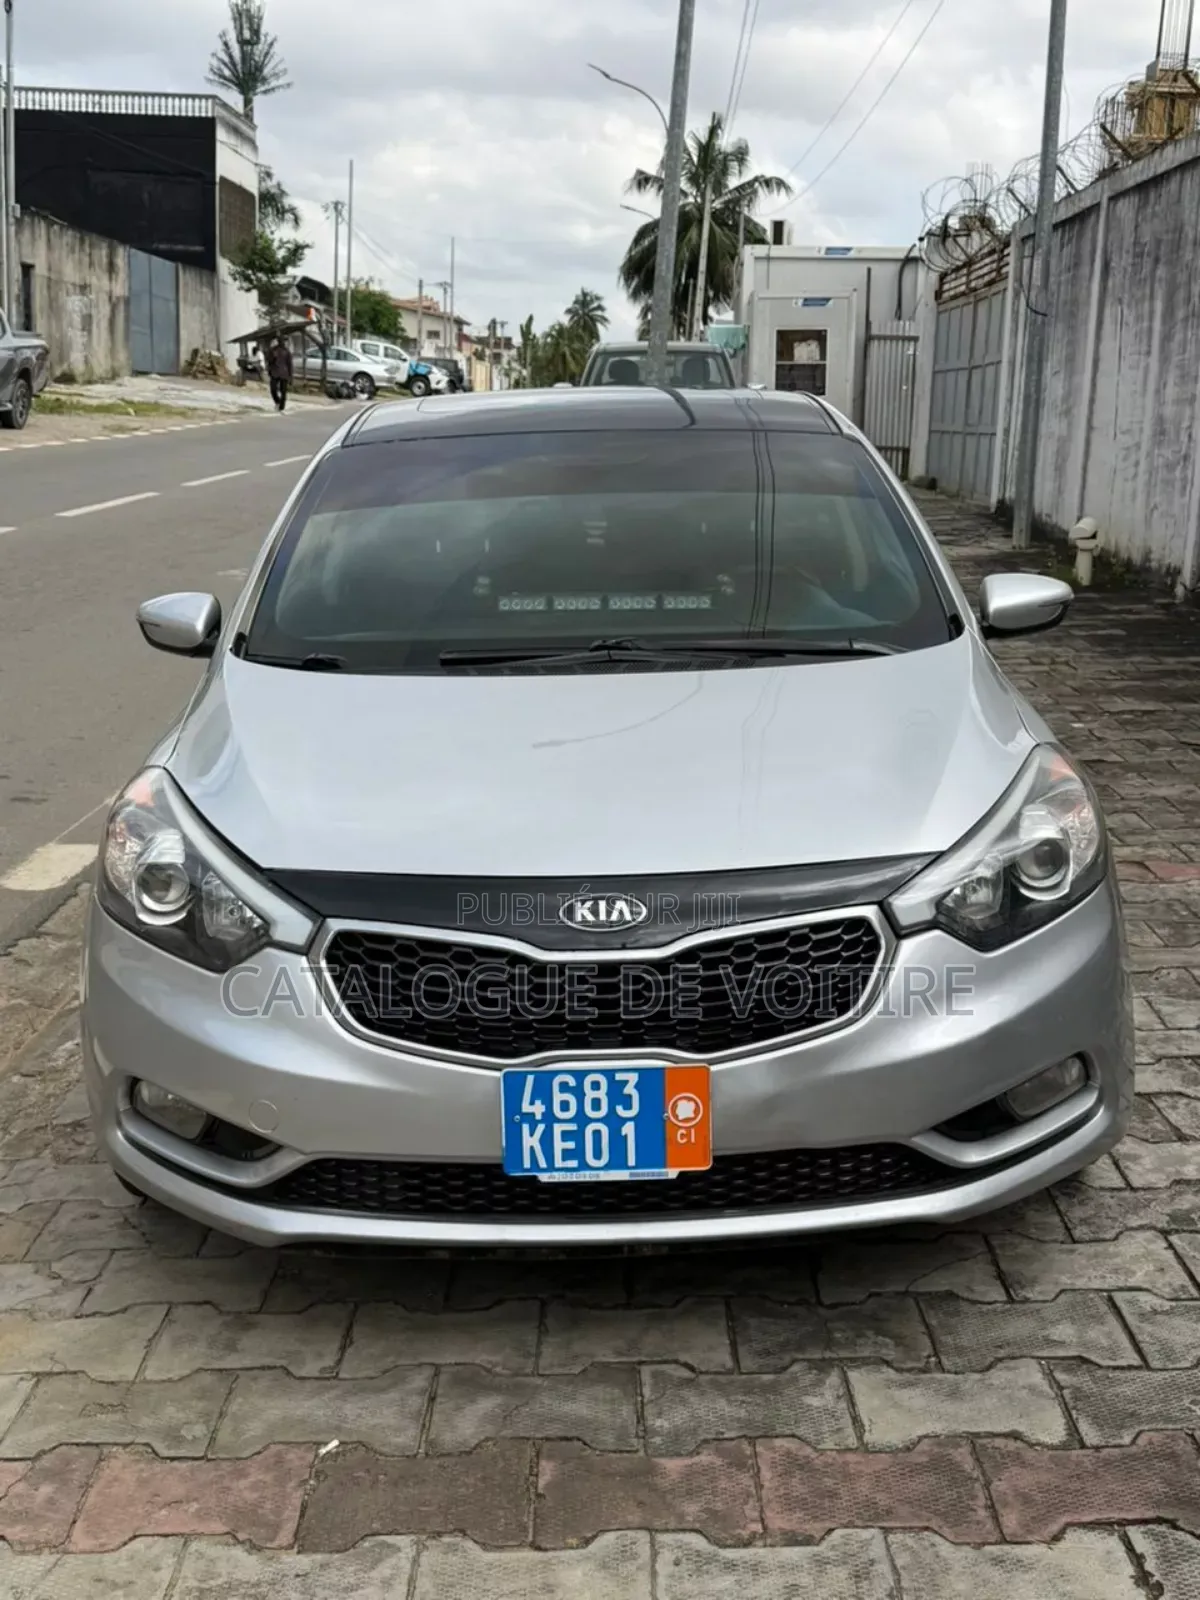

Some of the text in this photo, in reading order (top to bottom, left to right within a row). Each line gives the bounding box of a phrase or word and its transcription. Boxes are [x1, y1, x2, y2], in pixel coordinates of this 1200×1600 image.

[574, 899, 633, 923] KIA
[521, 1072, 640, 1120] 4683
[521, 1121, 637, 1169] KE01
[676, 1129, 696, 1144] CI
